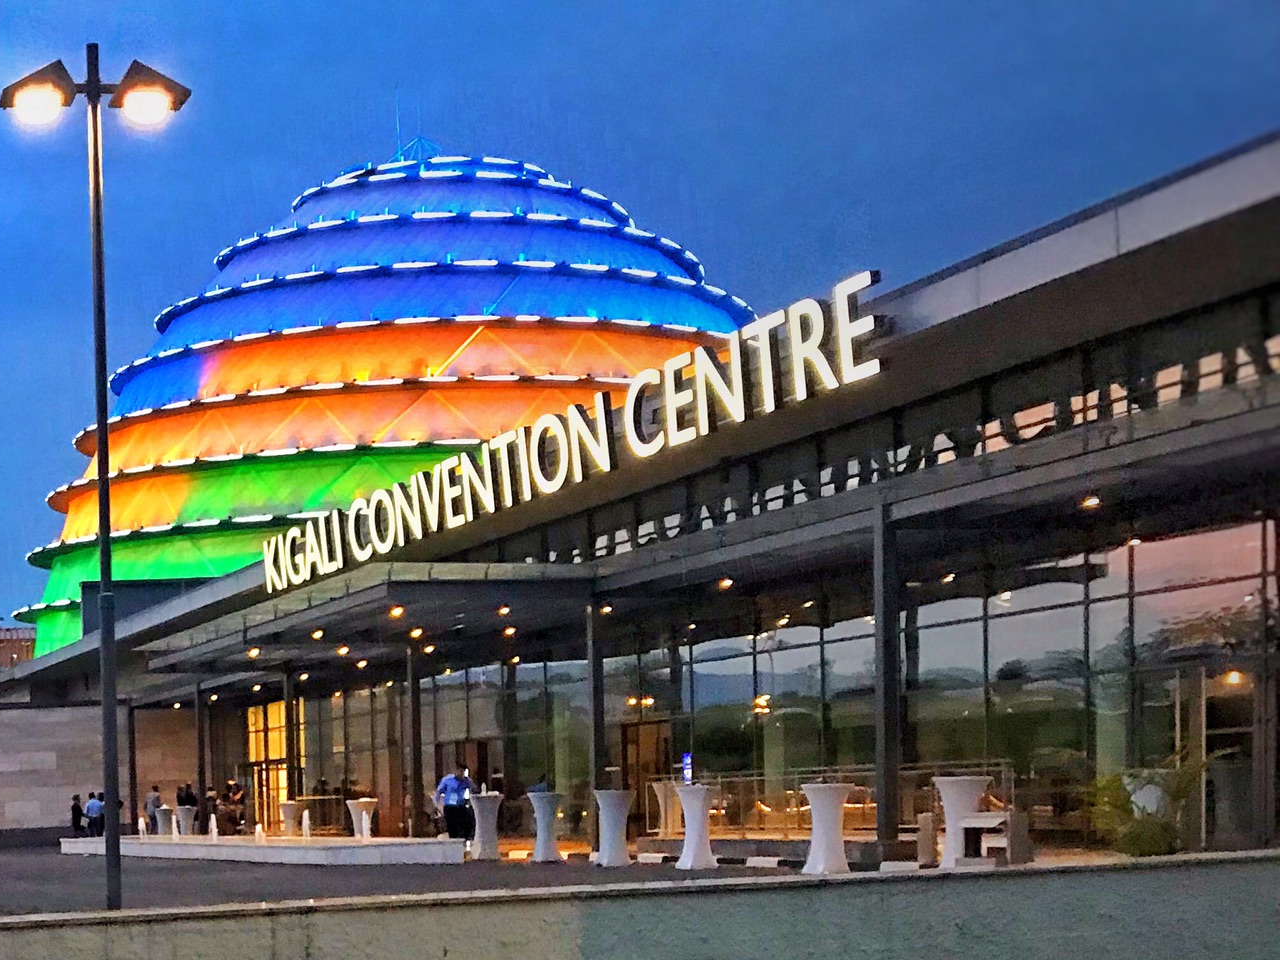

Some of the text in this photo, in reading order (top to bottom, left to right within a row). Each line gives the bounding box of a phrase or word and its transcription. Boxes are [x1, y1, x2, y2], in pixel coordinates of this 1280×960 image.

[262, 270, 881, 594] KIGALI CONVENTION CENTRE
